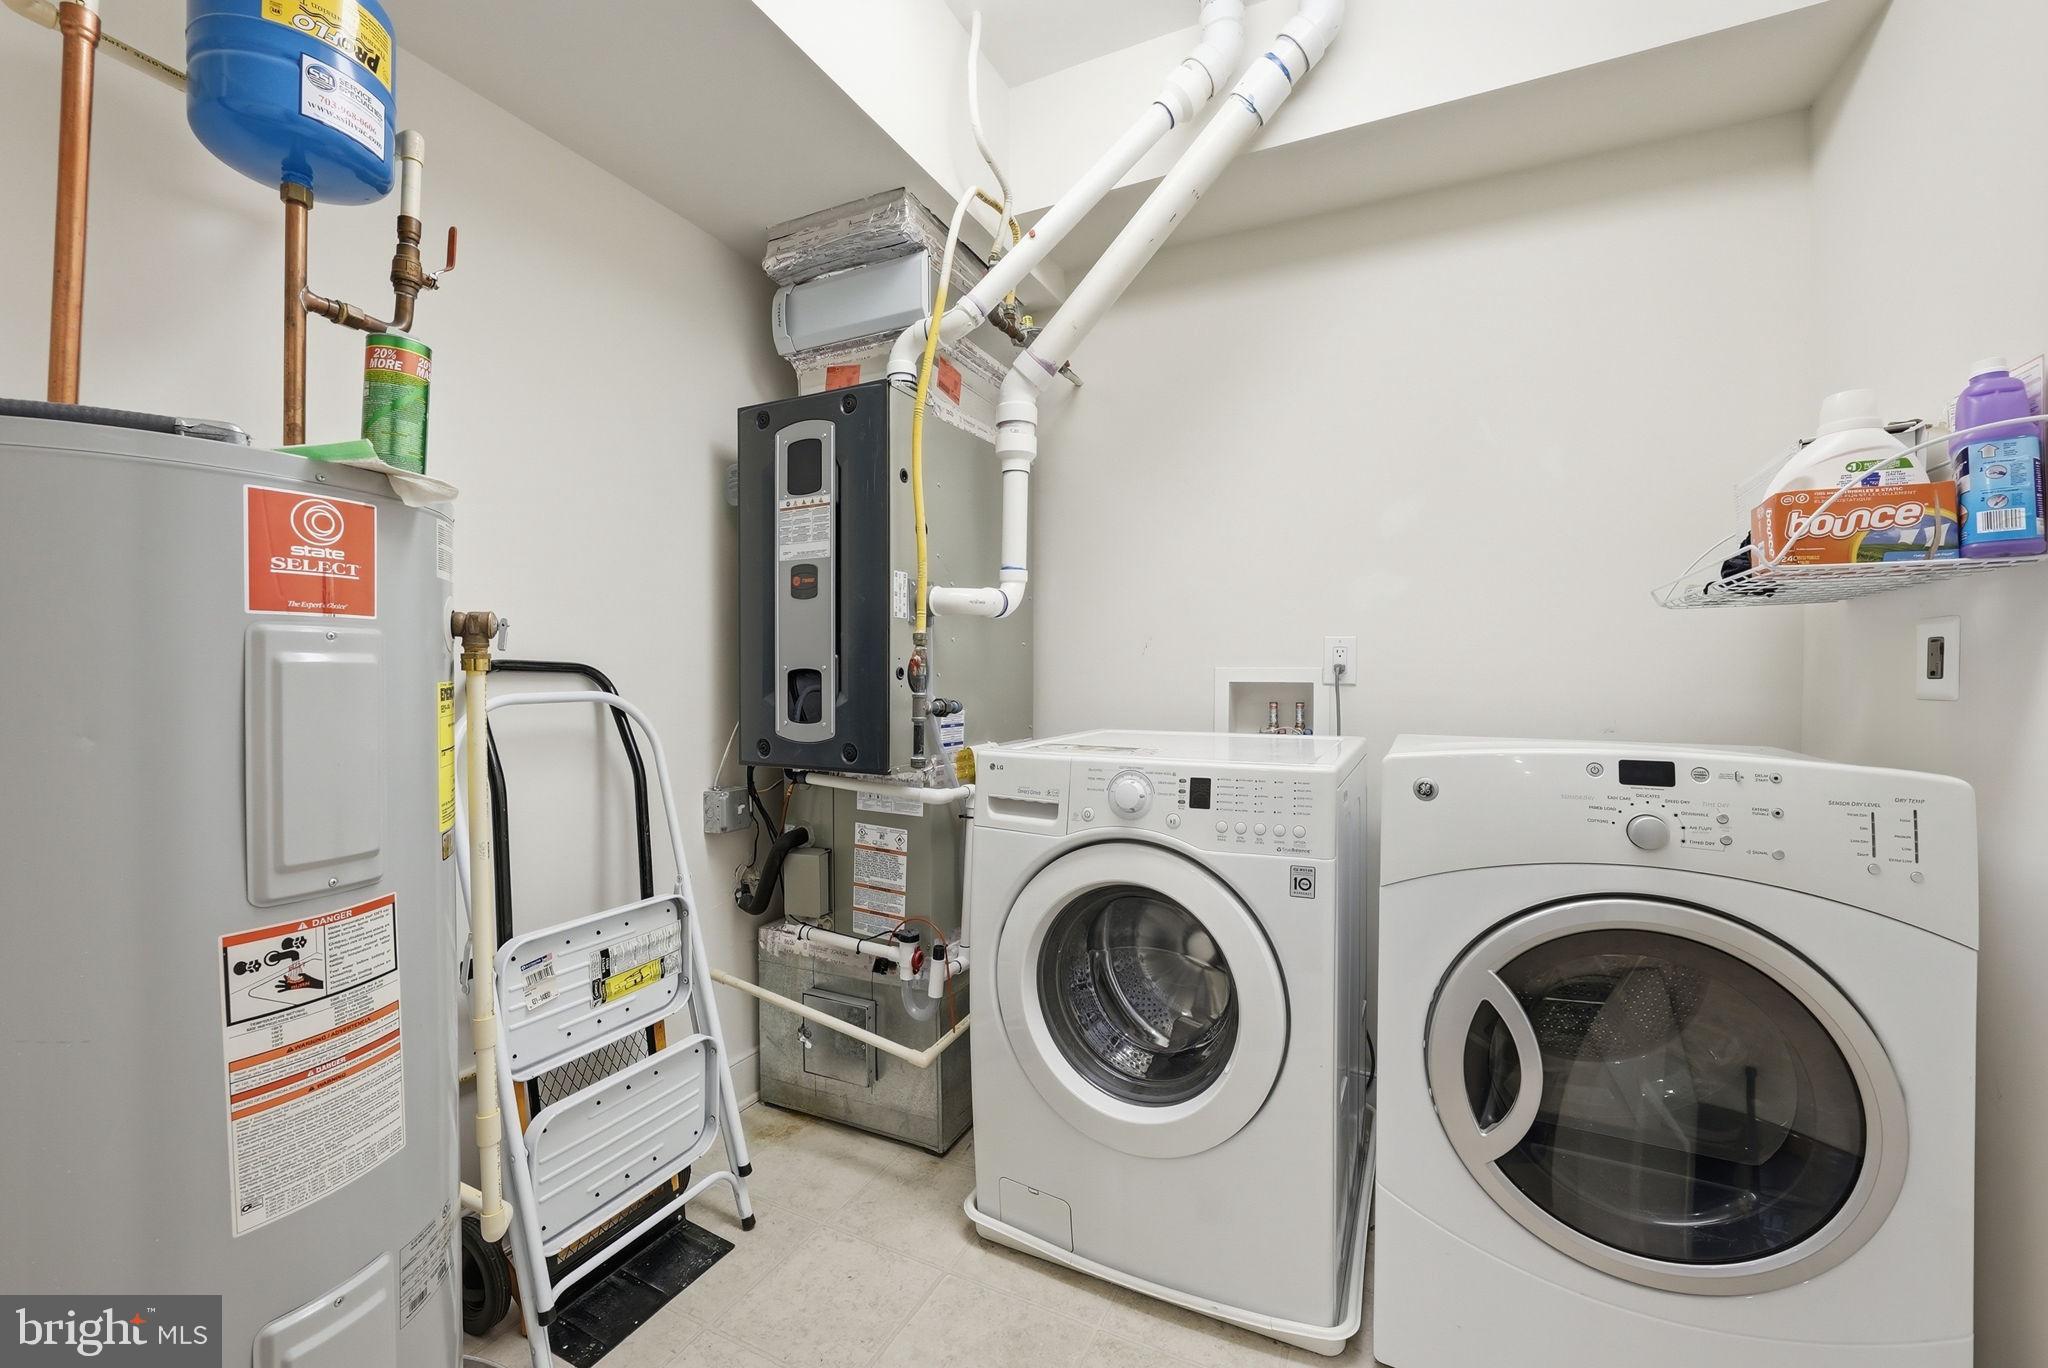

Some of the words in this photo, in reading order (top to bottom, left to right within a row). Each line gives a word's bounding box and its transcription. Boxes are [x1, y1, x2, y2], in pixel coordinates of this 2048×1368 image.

[291, 13, 380, 75] PROFLO
[339, 77, 373, 104] SERVICE
[373, 347, 397, 360] 20%
[369, 358, 404, 371] MORE
[1786, 502, 1924, 539] bounce
[1765, 508, 1775, 558] bounce
[290, 545, 345, 560] state
[270, 556, 360, 577] SELECT
[288, 600, 301, 608] The
[311, 909, 353, 927] DANGER
